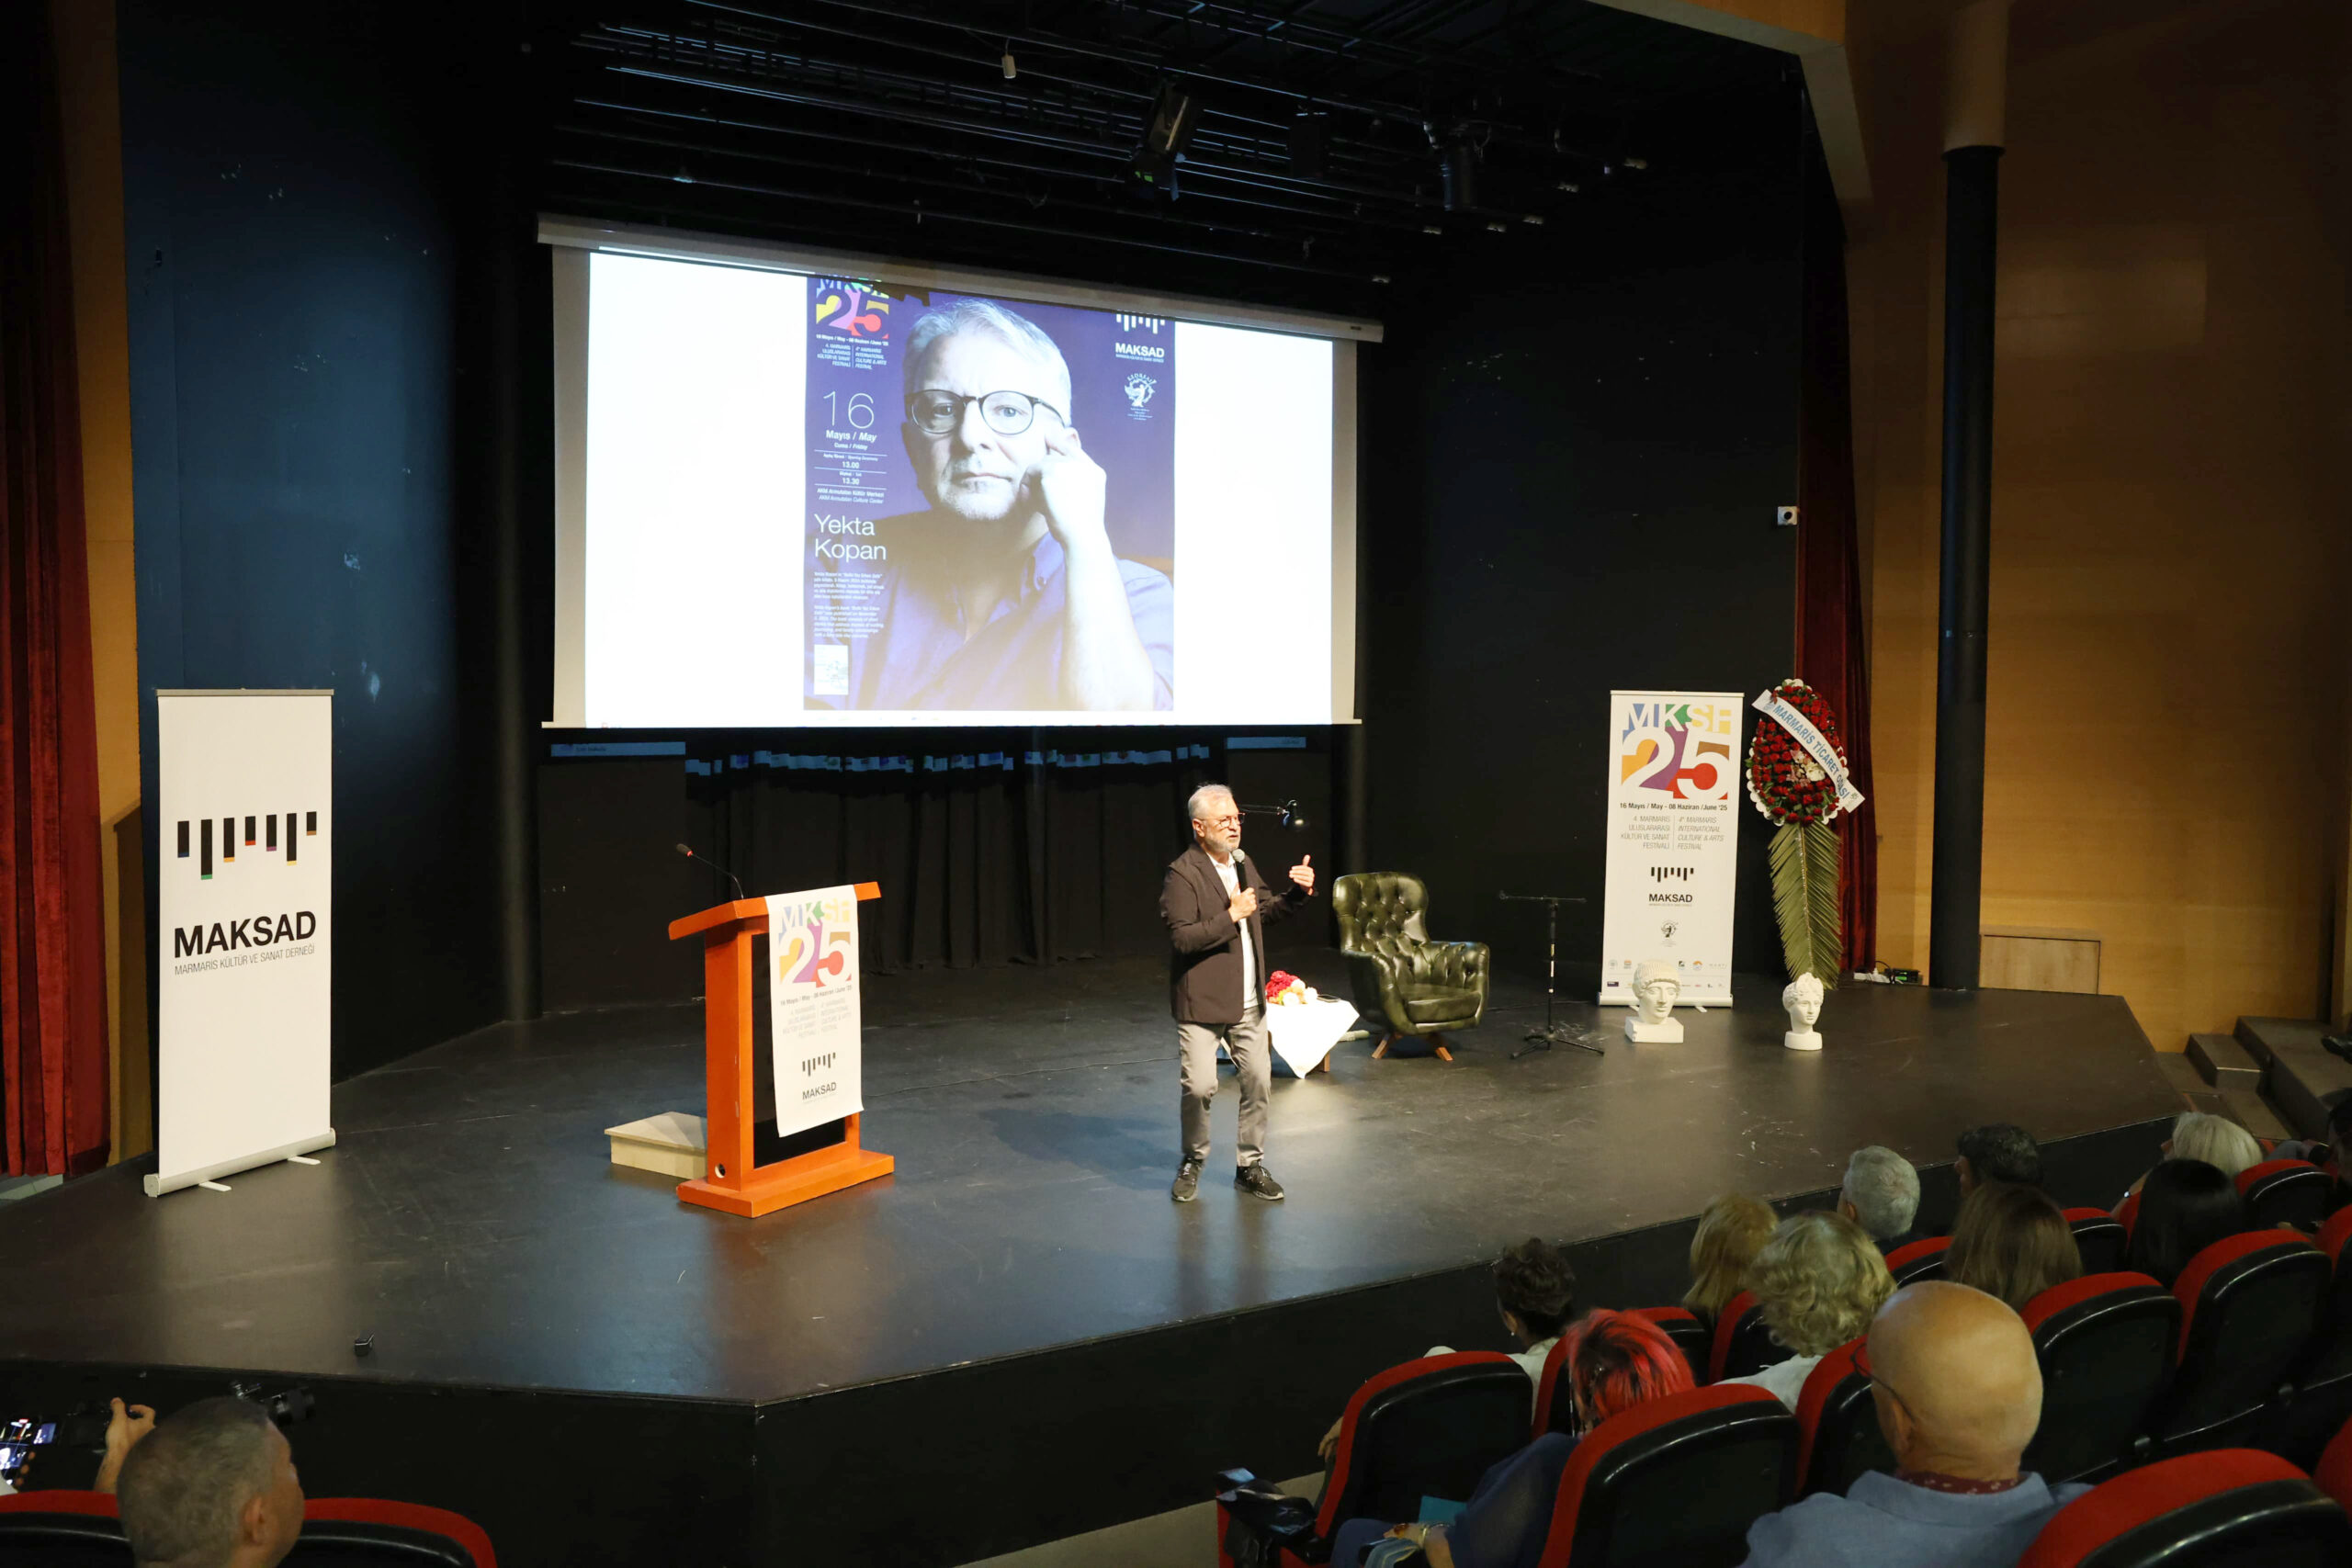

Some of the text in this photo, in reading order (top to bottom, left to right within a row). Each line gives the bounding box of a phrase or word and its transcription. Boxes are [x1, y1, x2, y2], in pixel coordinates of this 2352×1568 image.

[816, 288, 889, 340] 25
[1115, 343, 1165, 358] MAKSAD
[823, 390, 876, 429] 16
[852, 443, 868, 451] Friday
[858, 432, 877, 444] May
[842, 477, 860, 485] 13.30
[814, 513, 876, 536] Yekta
[814, 537, 888, 563] Kopan
[1772, 705, 1815, 744] MARMARİS
[1813, 741, 1838, 776] TİCARET
[1622, 726, 1731, 800] 25
[1650, 802, 1664, 811] May
[1709, 834, 1725, 842] ARTS
[1648, 893, 1693, 903] MAKSAD
[175, 910, 316, 958] MAKSAD
[175, 943, 315, 976] MARMARİS KÜLTÜR VE SANAT DERNEĞİ
[779, 927, 853, 988] 25
[802, 1081, 837, 1100] MAKSAD
